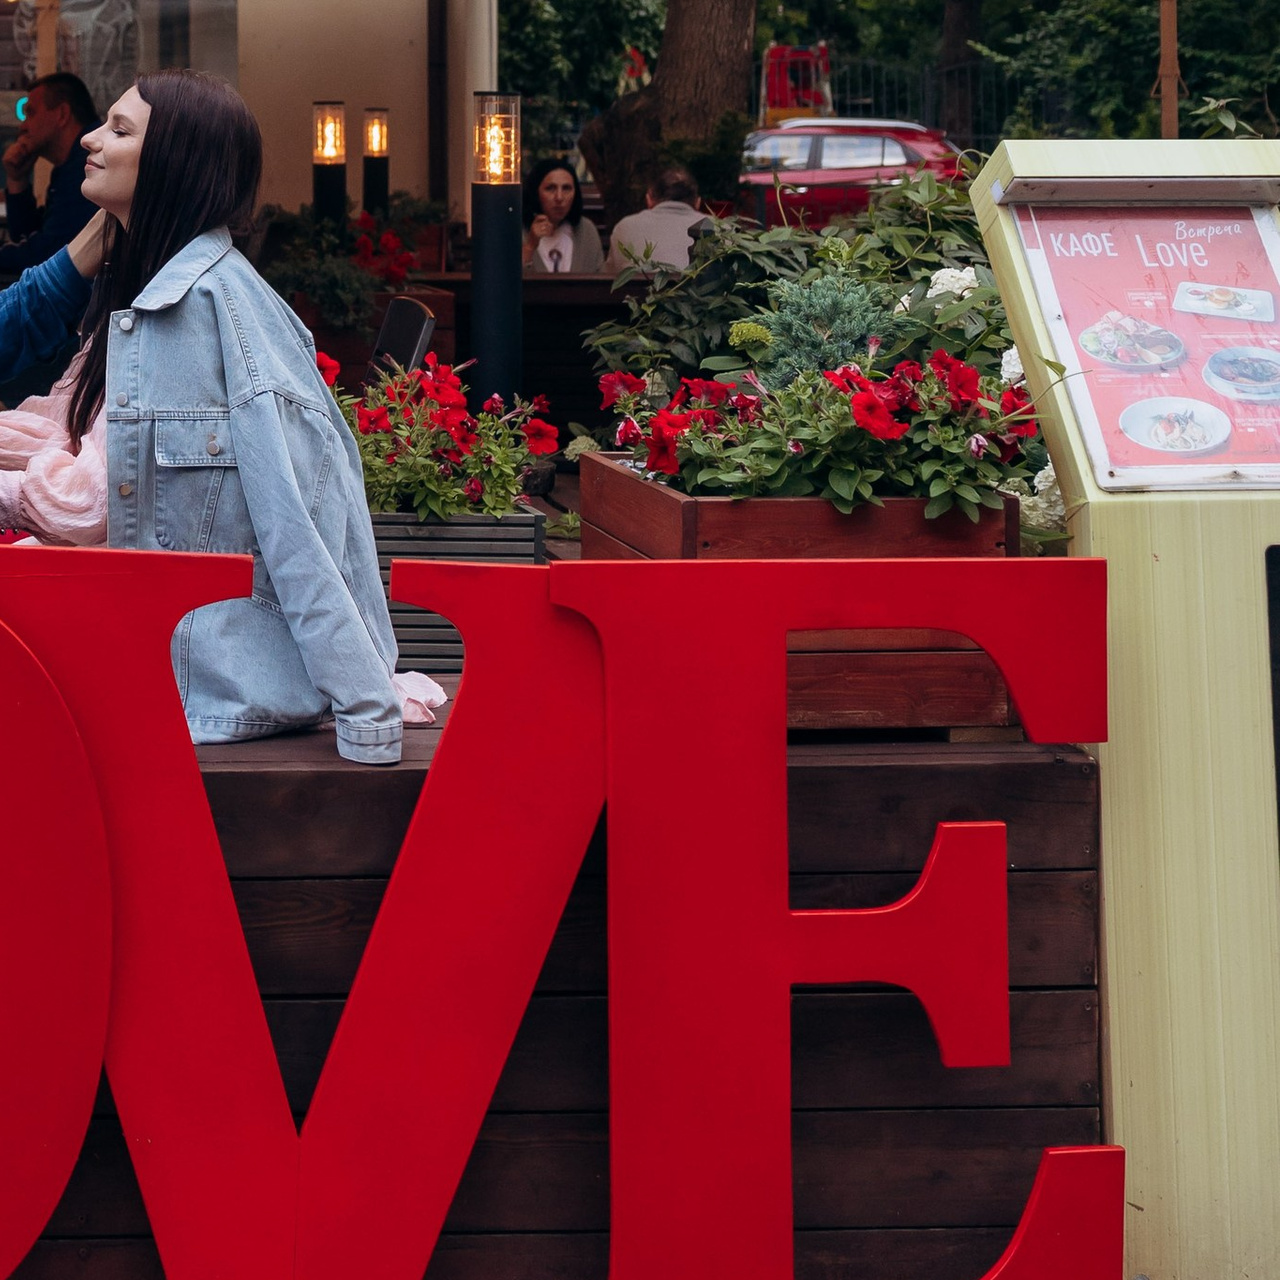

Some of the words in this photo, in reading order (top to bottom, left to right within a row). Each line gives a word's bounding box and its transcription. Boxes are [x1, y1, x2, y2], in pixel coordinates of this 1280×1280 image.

[1175, 220, 1243, 243] Встреча
[1050, 231, 1119, 257] КАФЕ
[1135, 234, 1210, 268] Love
